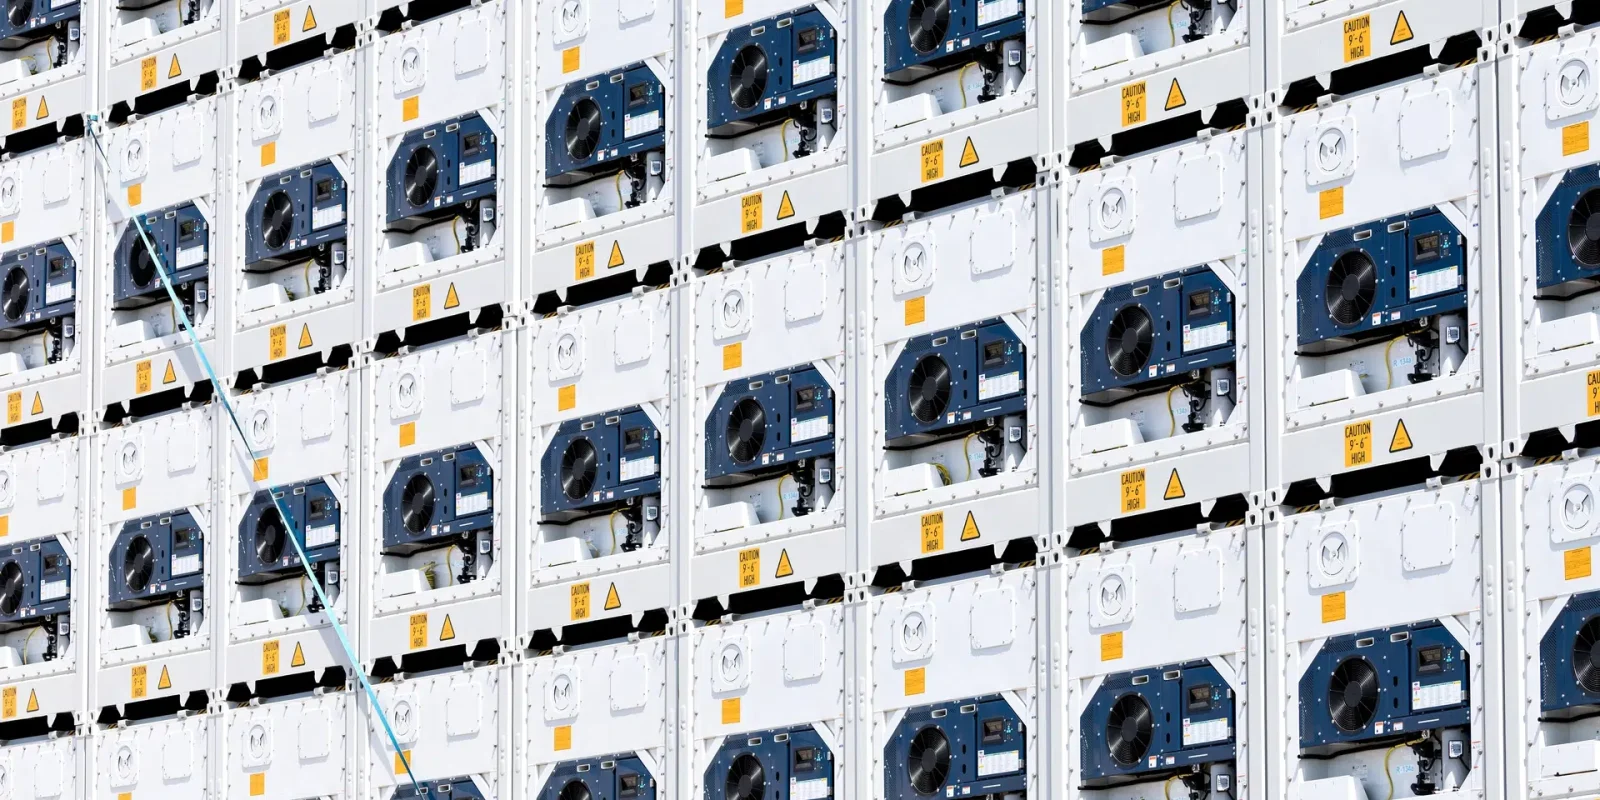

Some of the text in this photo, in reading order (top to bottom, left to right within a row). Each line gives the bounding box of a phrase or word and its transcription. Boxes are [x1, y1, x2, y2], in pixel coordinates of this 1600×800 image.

[1344, 16, 1370, 33] CAUTION
[1350, 45, 1365, 59] HIGH
[1122, 83, 1146, 99] CAUTION
[1128, 110, 1141, 123] HIGH
[921, 141, 943, 156] CAUTION
[926, 167, 938, 179] HIGH
[1345, 423, 1372, 438] CAUTION
[1352, 450, 1366, 464] HIGH
[1121, 471, 1146, 485] CAUTION
[1127, 497, 1141, 510] HIGH
[921, 514, 944, 527] CAUTION
[927, 538, 939, 551] HIGH
